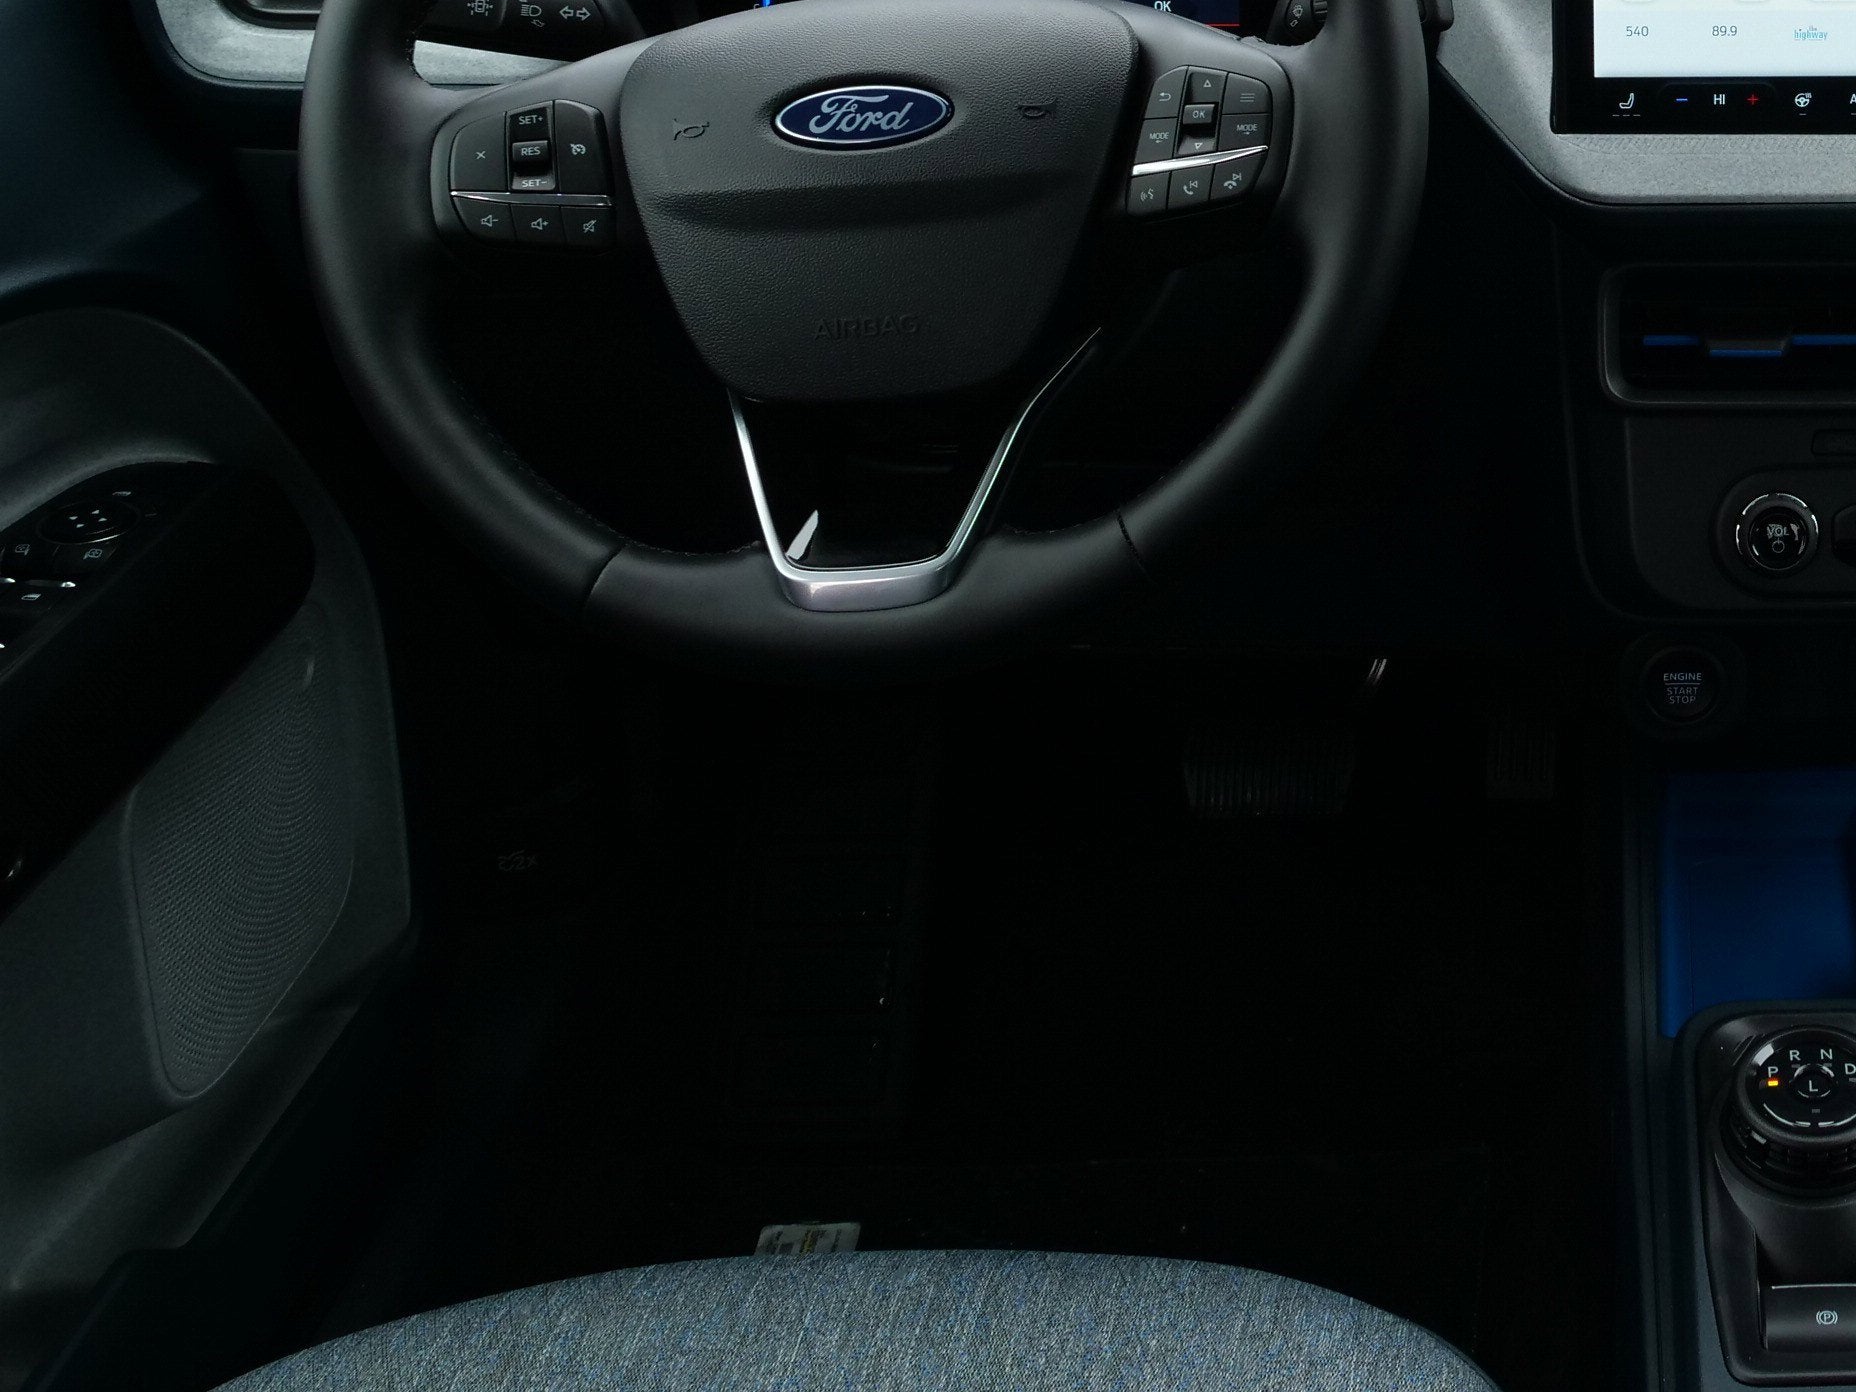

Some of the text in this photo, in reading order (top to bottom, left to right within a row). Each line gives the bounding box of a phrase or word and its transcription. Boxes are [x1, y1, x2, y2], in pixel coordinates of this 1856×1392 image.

[1154, 0, 1171, 12] OK
[1626, 26, 1649, 37] 540
[1712, 25, 1737, 37] 89.9
[1793, 28, 1828, 41] highway
[1714, 94, 1726, 105] HI
[519, 115, 543, 125] SET+
[809, 95, 914, 134] Ford
[1192, 110, 1205, 119] OK
[1149, 132, 1169, 140] MODE
[521, 147, 541, 156] RES
[814, 312, 921, 340] AIRBAG
[1767, 526, 1789, 536] VOL
[1664, 673, 1702, 681] ENGINE
[1667, 687, 1698, 695] START
[1670, 696, 1696, 704] STOP
[1768, 1049, 1856, 1077] P R N D
[1809, 1080, 1818, 1091] L
